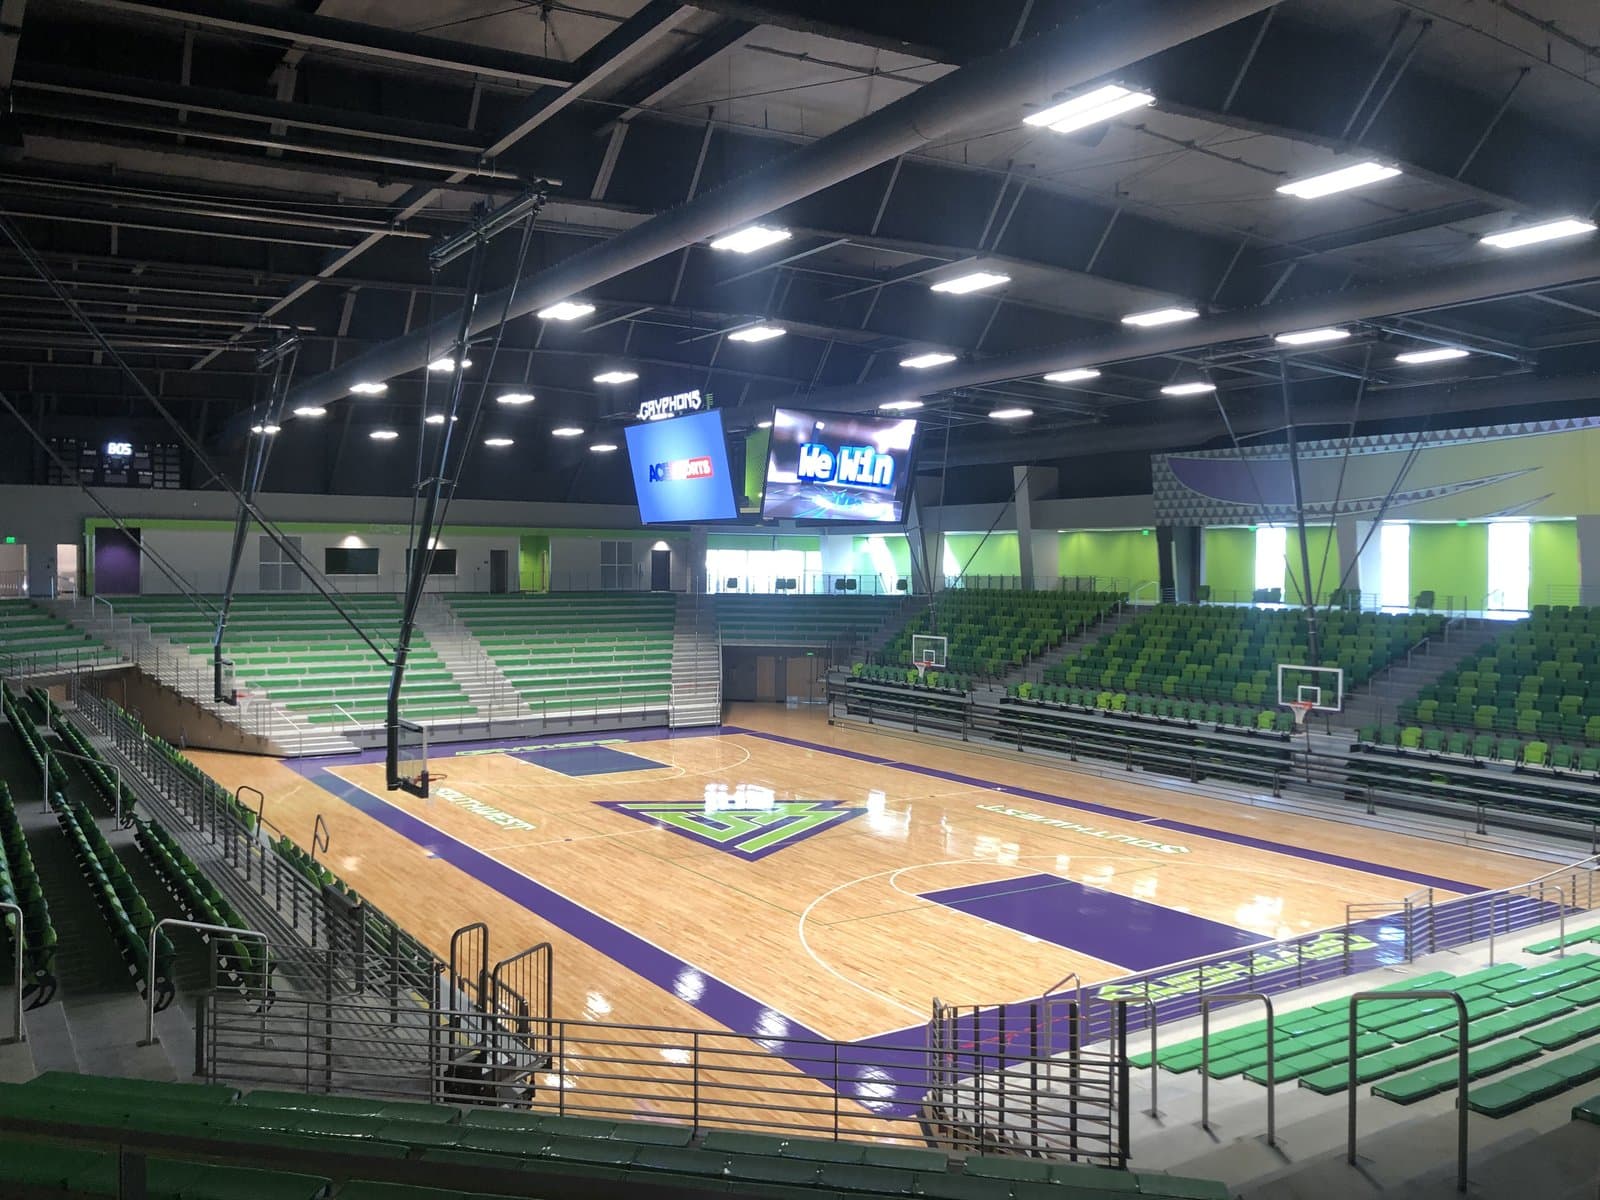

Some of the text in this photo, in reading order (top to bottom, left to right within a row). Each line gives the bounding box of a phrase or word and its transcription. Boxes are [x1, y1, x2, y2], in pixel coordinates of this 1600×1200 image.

[636, 389, 702, 420] GRYPHONS
[797, 443, 894, 487] We Win
[435, 787, 536, 831] SOUTHWEST
[976, 803, 1191, 854] SOUTHWEST
